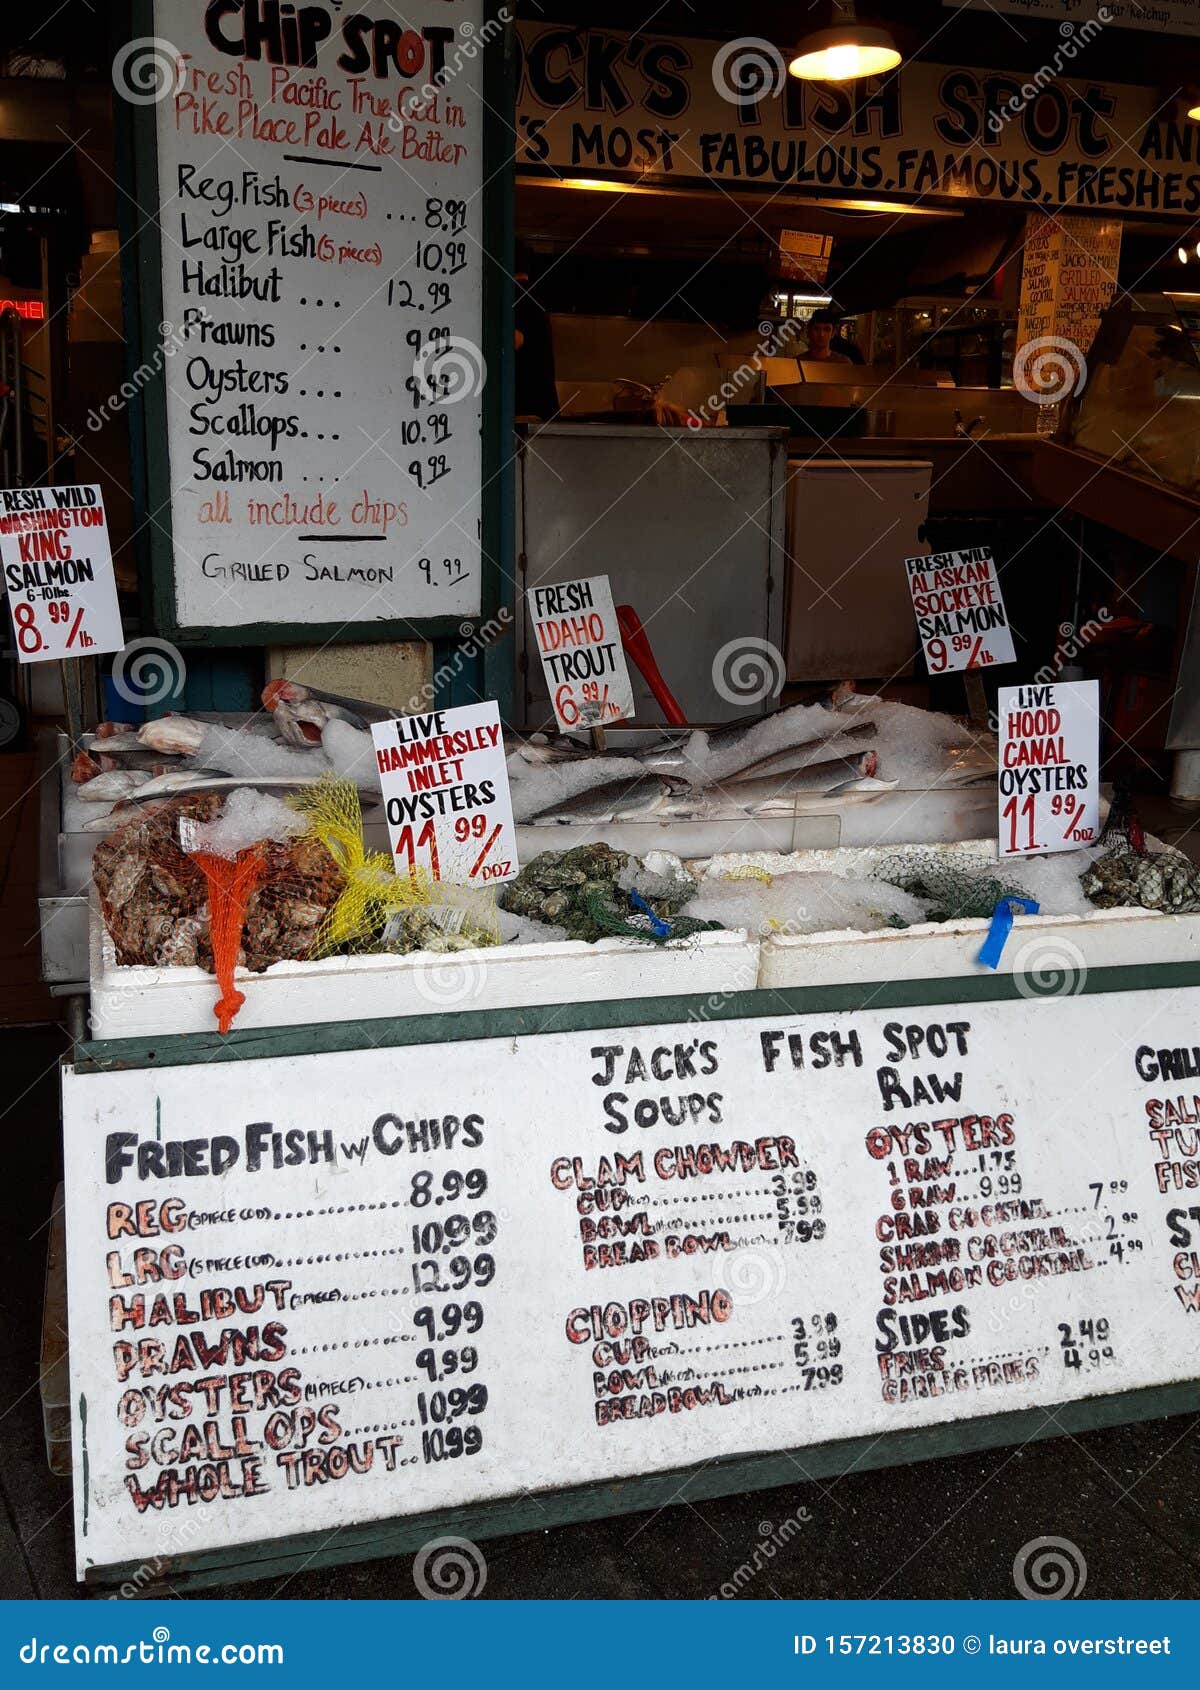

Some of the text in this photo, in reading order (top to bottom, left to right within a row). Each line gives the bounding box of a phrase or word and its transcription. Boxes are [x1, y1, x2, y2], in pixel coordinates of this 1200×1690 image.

[336, 14, 455, 86] SPOT
[174, 54, 254, 99] Fresh
[271, 66, 342, 111] Pacific
[346, 77, 391, 119] True
[445, 95, 466, 128] in
[238, 99, 302, 145] Place
[304, 111, 351, 152] Pale
[354, 123, 396, 157] Ale
[401, 128, 469, 167] Batter
[424, 197, 468, 237] 8.99
[181, 213, 261, 263] Large
[267, 219, 318, 259] Fish
[416, 240, 468, 275] 10.99
[182, 260, 452, 314] Halibut 12.99
[183, 308, 276, 348] Prawns
[186, 355, 289, 404] Oysters
[189, 403, 452, 451] Scallops 10.99
[192, 447, 452, 490] Salmon 9.99
[51, 486, 97, 509] WILD
[199, 488, 409, 533] all include chips
[0, 507, 104, 535] WASHINGTON
[18, 528, 73, 563] KING
[907, 546, 992, 575] FRESH WILD
[6, 557, 95, 592] SALMON
[911, 560, 991, 595] ALASKAN
[534, 581, 594, 618] FRESH
[914, 581, 999, 618] SOCKEYE
[536, 612, 604, 652] IDAHO
[918, 603, 1006, 640] SALMON
[544, 642, 617, 684] TROUT
[1018, 685, 1056, 709] LIVE
[396, 711, 448, 744] LIVE
[1008, 708, 1061, 740] HOOD
[376, 723, 500, 774] HAMMERSLEY
[1003, 736, 1072, 769] CANAL
[406, 758, 464, 793] INLET
[999, 764, 1088, 796] OYSTERS
[386, 780, 497, 826] OYSTERS
[590, 1021, 972, 1087] JACK'S FISH SPOT
[876, 1065, 964, 1112] RAW
[602, 1091, 725, 1135] SOUPS
[105, 1131, 240, 1184] FRIED
[245, 1121, 334, 1173] FISH
[372, 1112, 486, 1156] CHIPS
[865, 1112, 1016, 1160] OYSTERS
[550, 1134, 800, 1191] CLAM CHOWDER
[904, 1154, 954, 1184] RAW
[106, 1167, 489, 1240] REG 8.99
[577, 1187, 628, 1216] CUP
[908, 1182, 957, 1209] RAW
[979, 1171, 1023, 1199] 9.99
[579, 1211, 655, 1244] BOWL
[875, 1209, 942, 1243] CRAB
[106, 1210, 498, 1290] LRG 10.99
[583, 1238, 661, 1271] BREAD
[664, 1231, 737, 1260] BOWL
[108, 1252, 497, 1332] HALIBUT 12.99
[882, 1264, 983, 1307] SALMON
[986, 1248, 1096, 1288] COCKTAIL
[565, 1288, 734, 1344] CIOPPINO
[874, 1303, 971, 1352] SIDES
[113, 1300, 485, 1383] PRAWNS 9.99
[592, 1335, 650, 1369] CUP
[593, 1365, 659, 1399] BOWL
[877, 1345, 948, 1381] FRIES
[971, 1355, 1041, 1388] FRIES
[117, 1344, 480, 1428] OYSTERS 9.99
[416, 1382, 490, 1428] 10.99
[123, 1424, 484, 1514] WHOLE TROUT 10.99
